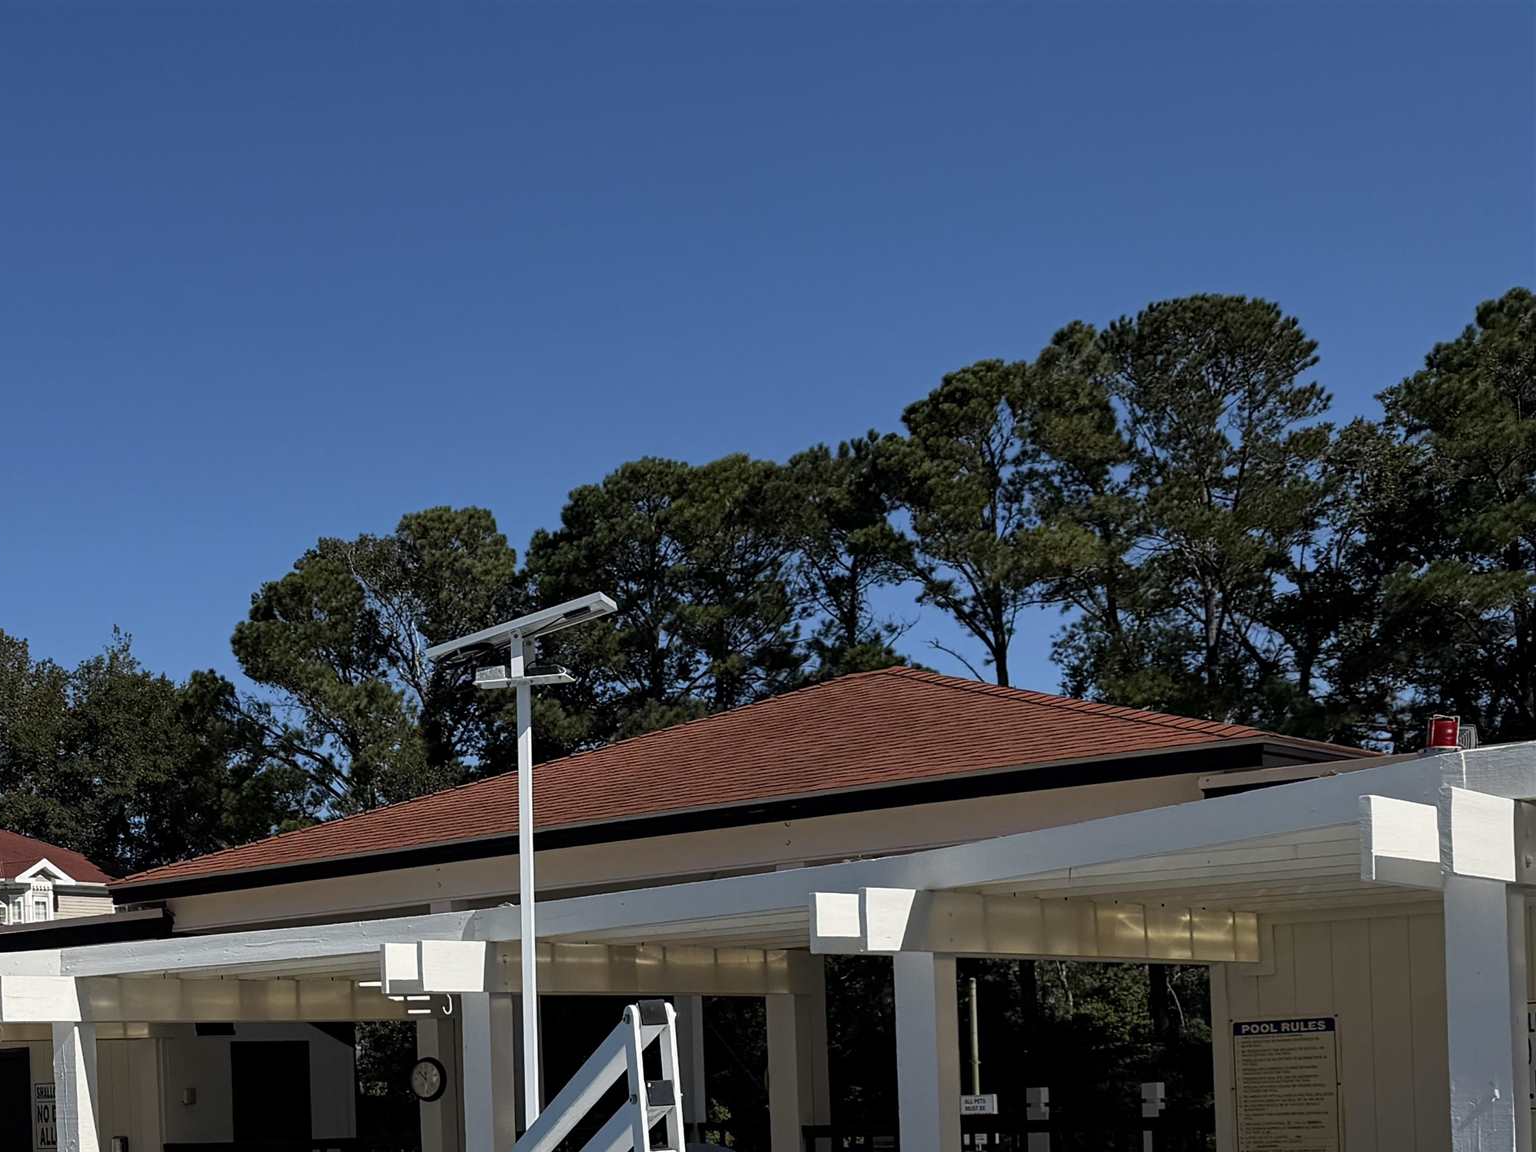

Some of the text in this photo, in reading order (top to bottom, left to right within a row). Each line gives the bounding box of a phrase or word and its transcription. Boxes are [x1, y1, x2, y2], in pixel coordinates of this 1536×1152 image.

[1241, 1021, 1327, 1034] POOL RULES
[37, 1104, 50, 1123] NO
